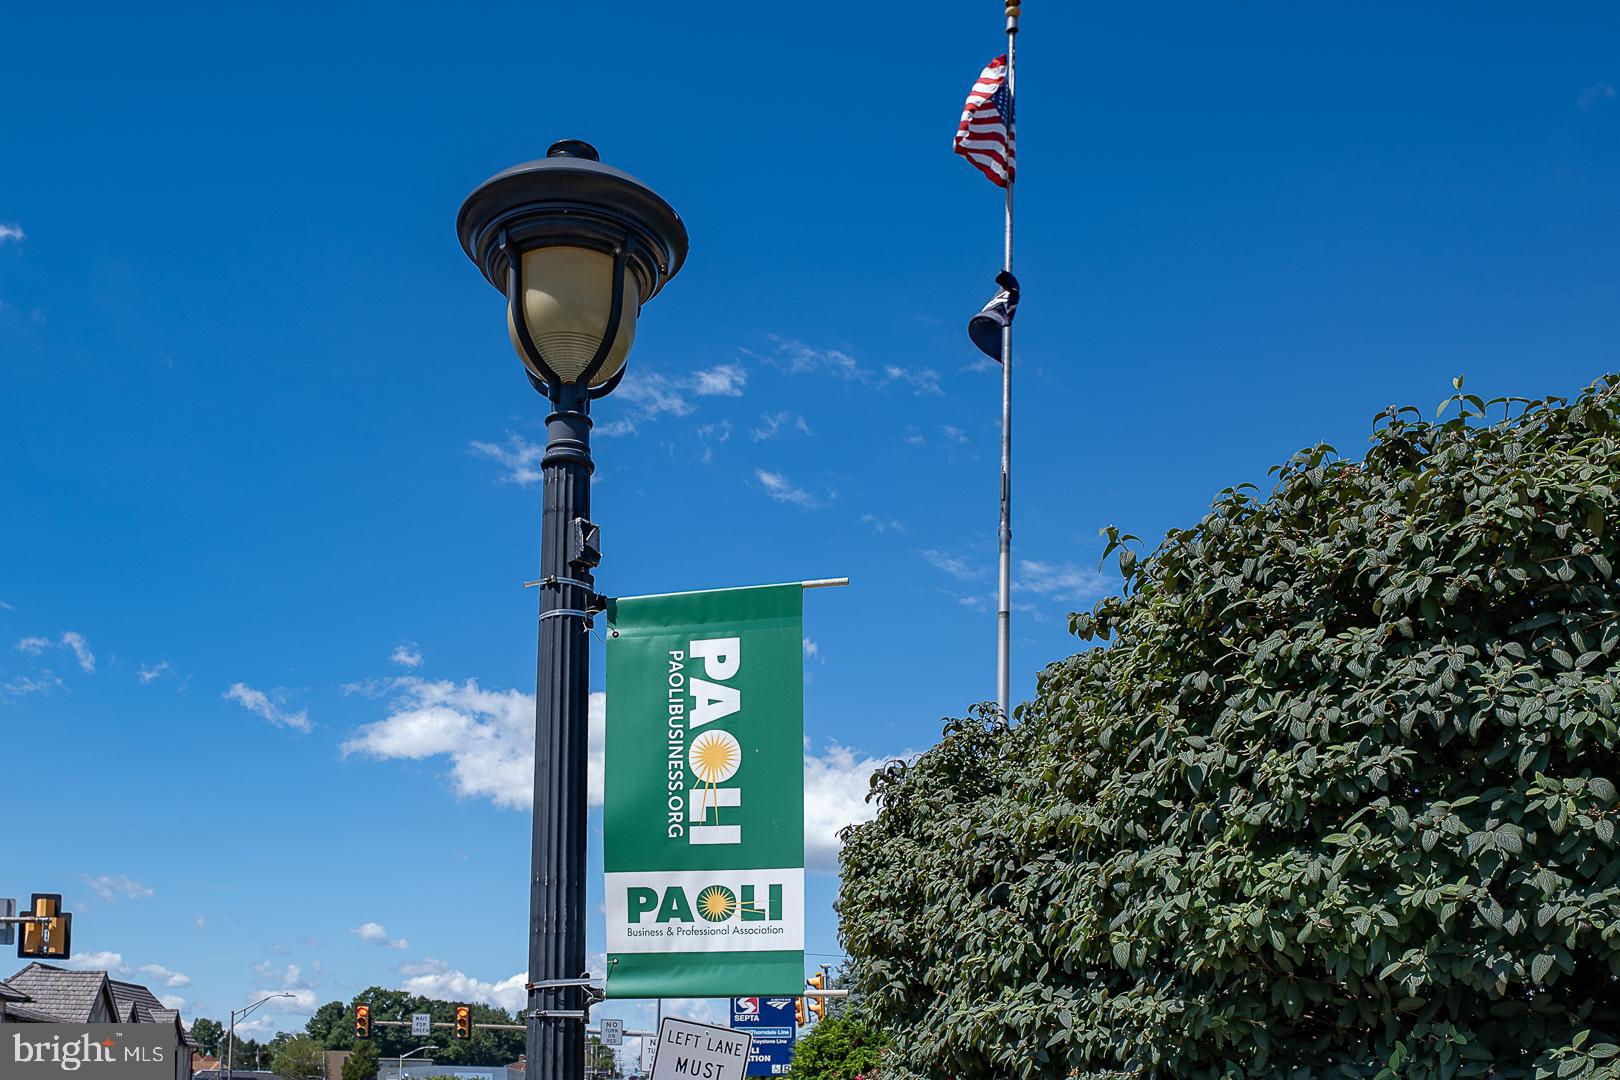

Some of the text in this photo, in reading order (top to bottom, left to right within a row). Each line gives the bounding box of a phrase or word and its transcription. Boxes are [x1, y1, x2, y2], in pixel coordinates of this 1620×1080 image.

[668, 650, 685, 839] PAOLIBUSINESS.ORG
[688, 637, 742, 845] PAOLI
[627, 884, 783, 923] PAOLI
[627, 925, 784, 937] Business & Professional Association
[734, 1014, 760, 1022] SEPTA
[667, 1029, 743, 1057] LEFT LANE
[675, 1056, 725, 1080] MUST
